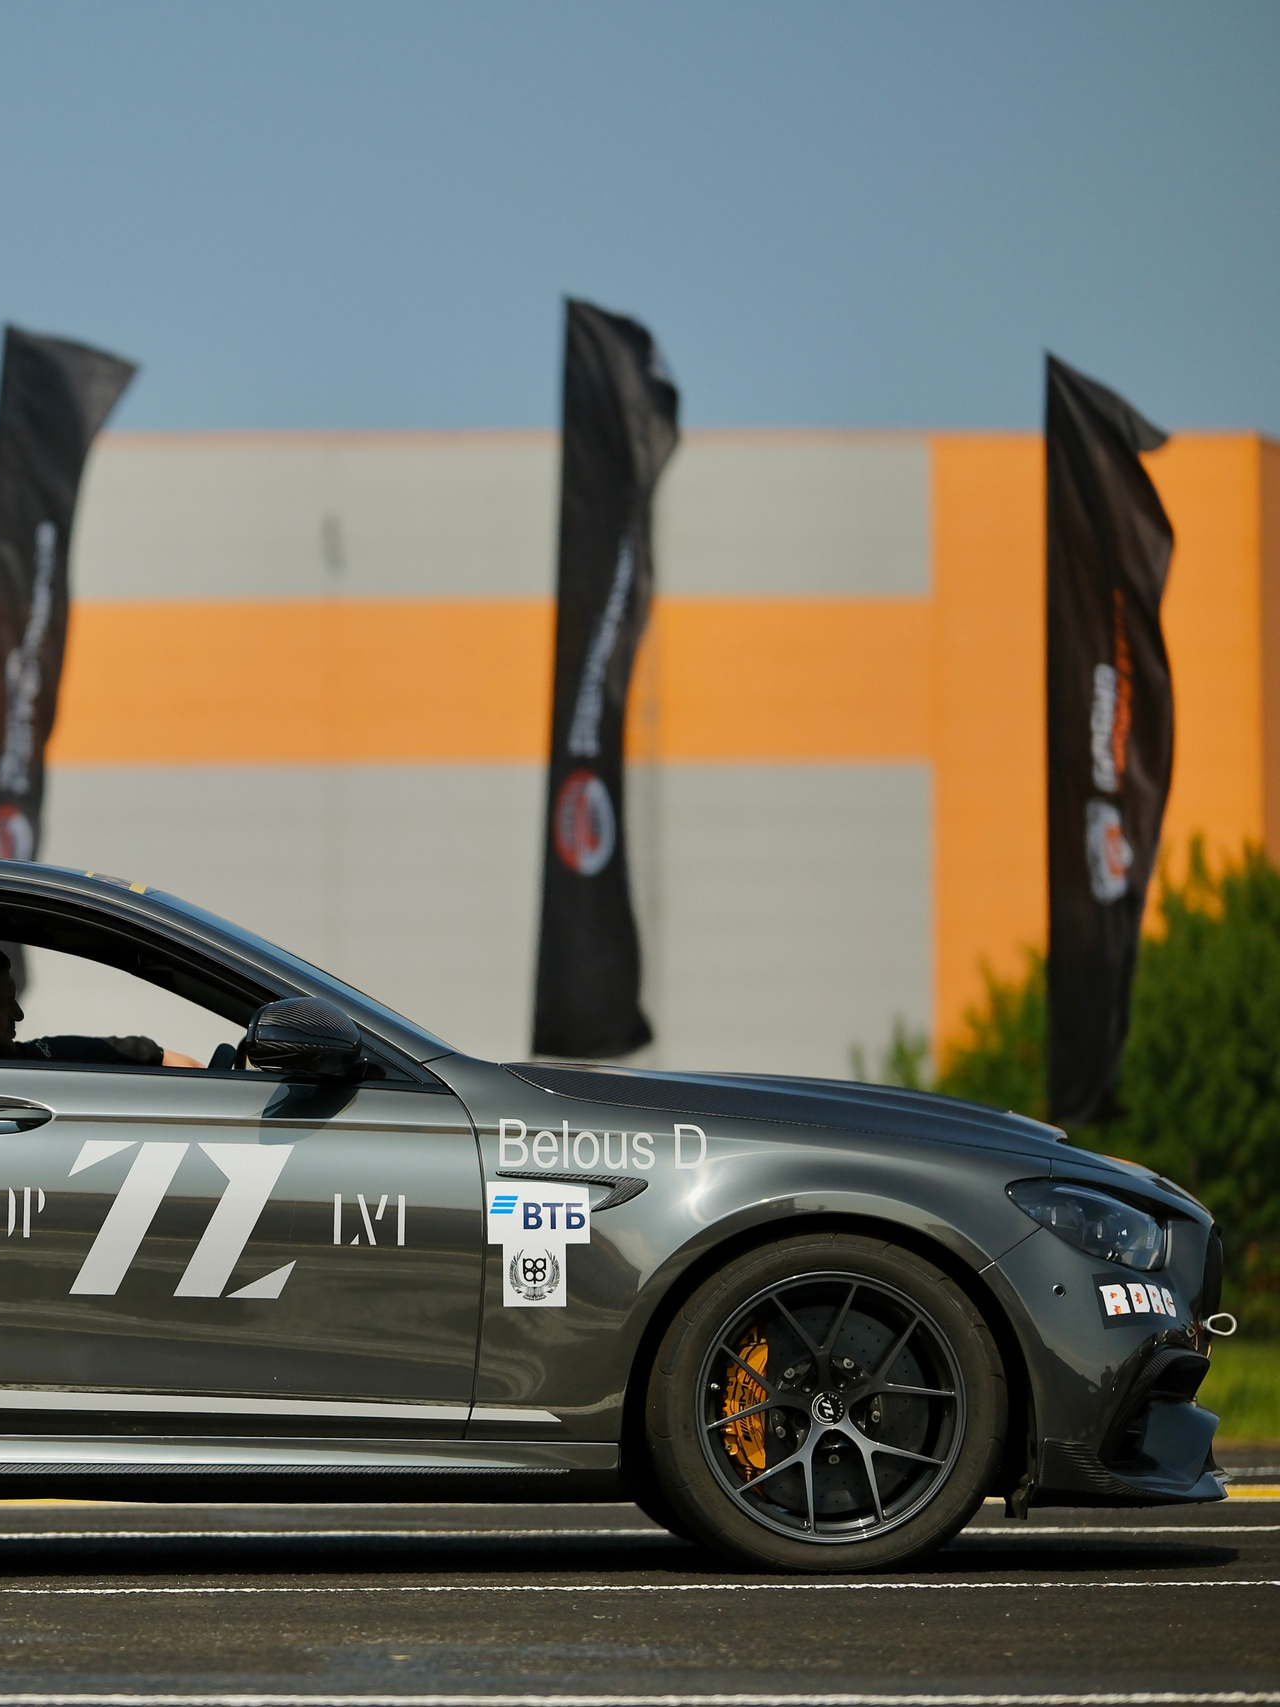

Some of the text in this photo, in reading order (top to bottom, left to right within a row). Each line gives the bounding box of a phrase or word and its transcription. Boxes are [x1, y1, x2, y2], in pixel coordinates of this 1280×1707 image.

[498, 1118, 708, 1169] Belous D
[522, 1202, 586, 1230] ВТБ
